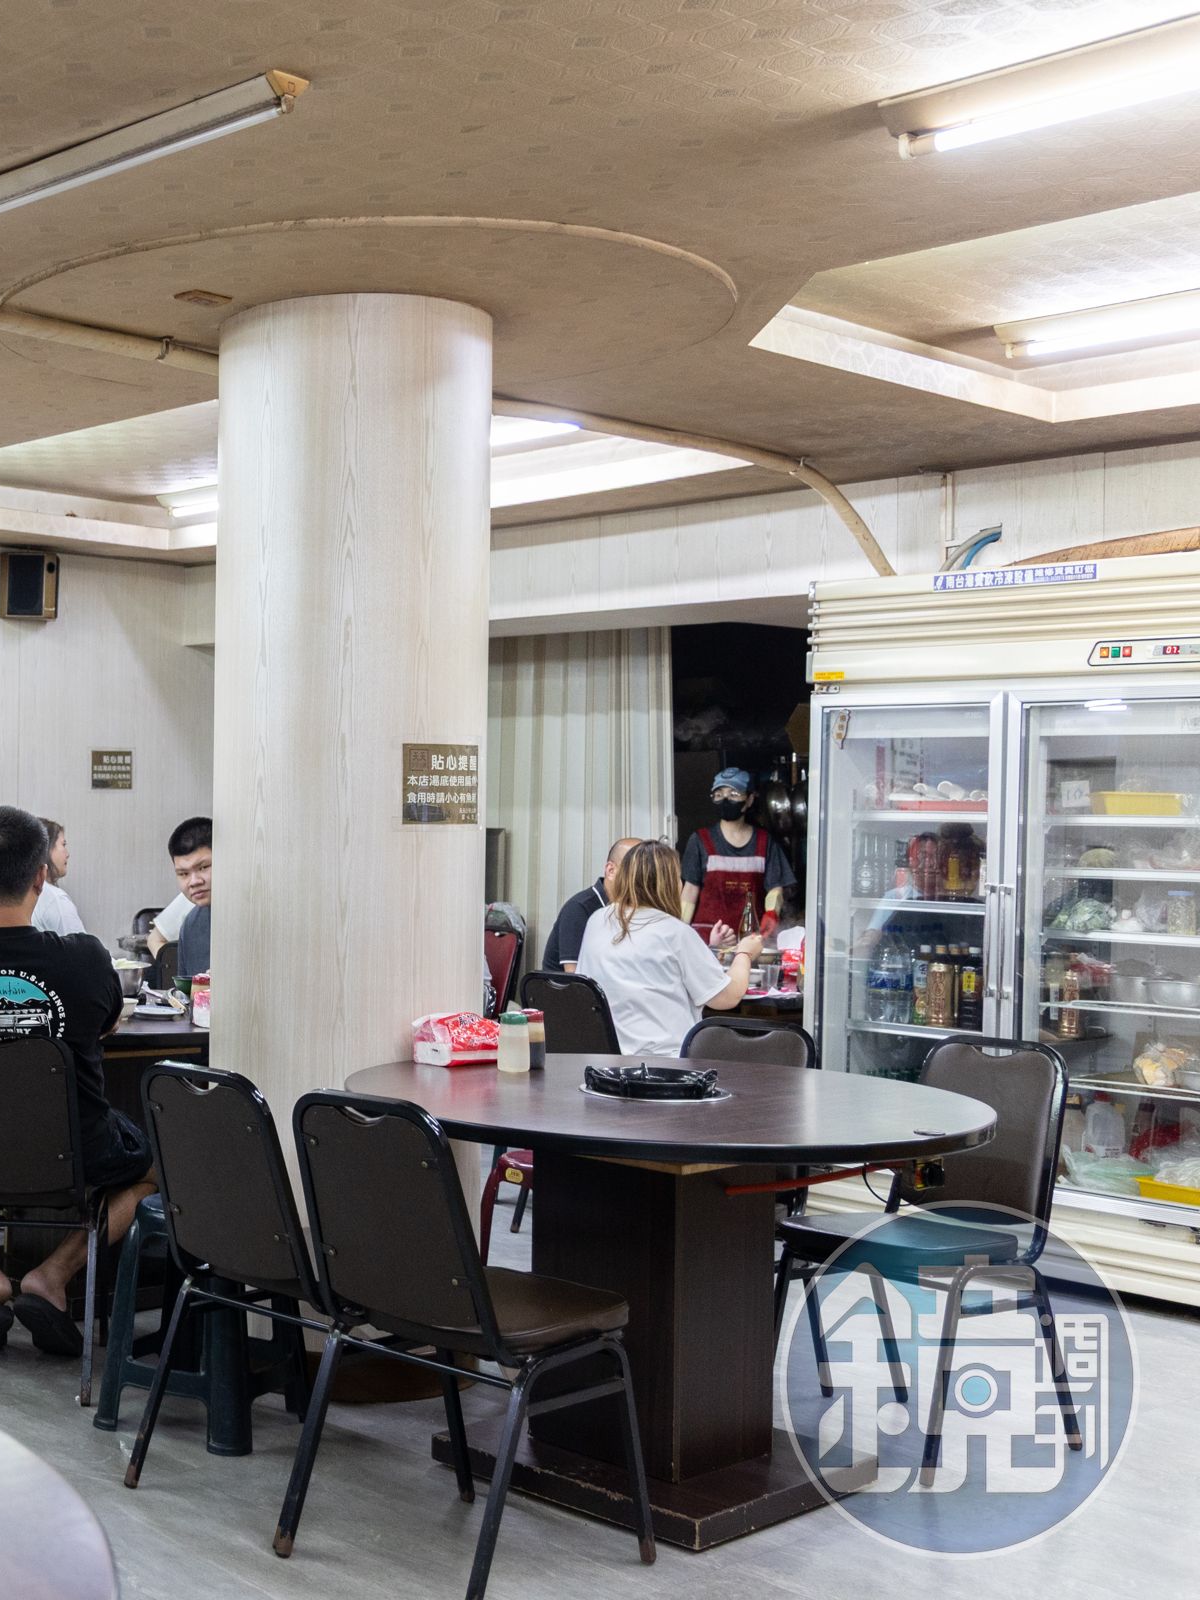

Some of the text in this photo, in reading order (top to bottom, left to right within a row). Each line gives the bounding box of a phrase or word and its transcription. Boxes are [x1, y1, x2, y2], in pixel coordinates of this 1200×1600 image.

[19, 970, 47, 990] U.S.A.
[48, 990, 65, 1019] SINCE
[56, 1022, 65, 1039] 194
